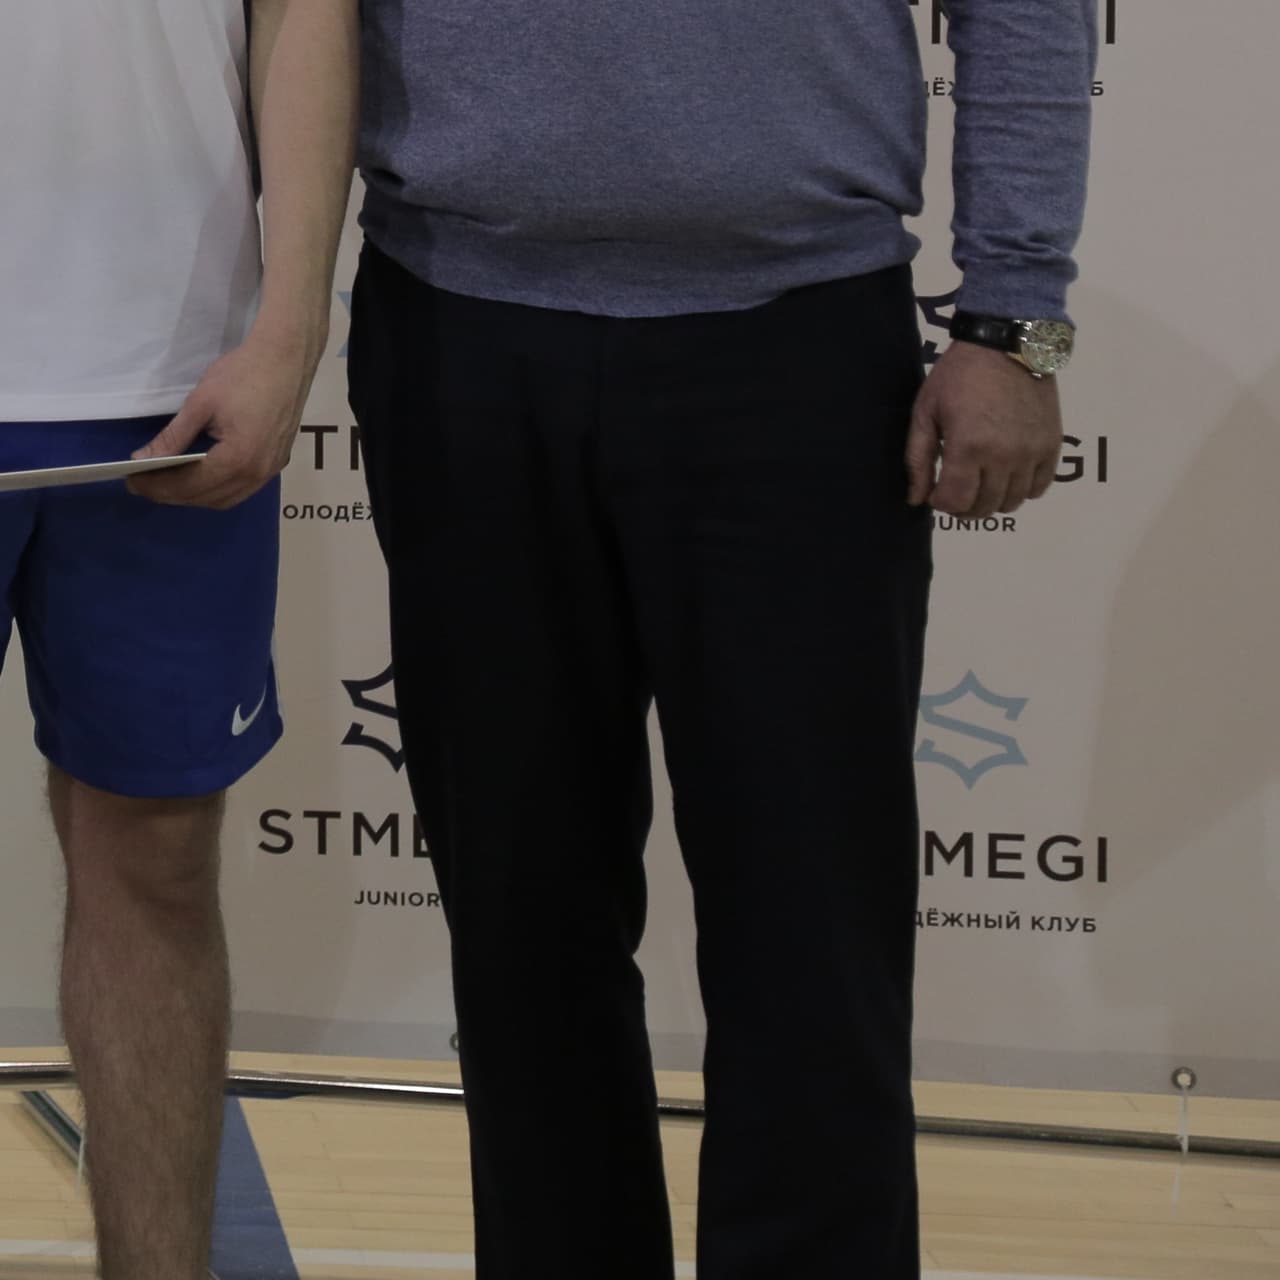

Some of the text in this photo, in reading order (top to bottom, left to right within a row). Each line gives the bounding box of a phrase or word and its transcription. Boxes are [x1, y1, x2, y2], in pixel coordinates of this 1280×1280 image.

[258, 809, 430, 858] STM
[924, 830, 1108, 883] MEGI
[354, 890, 440, 907] JUNIOR
[1031, 916, 1097, 934] КЛУБ
